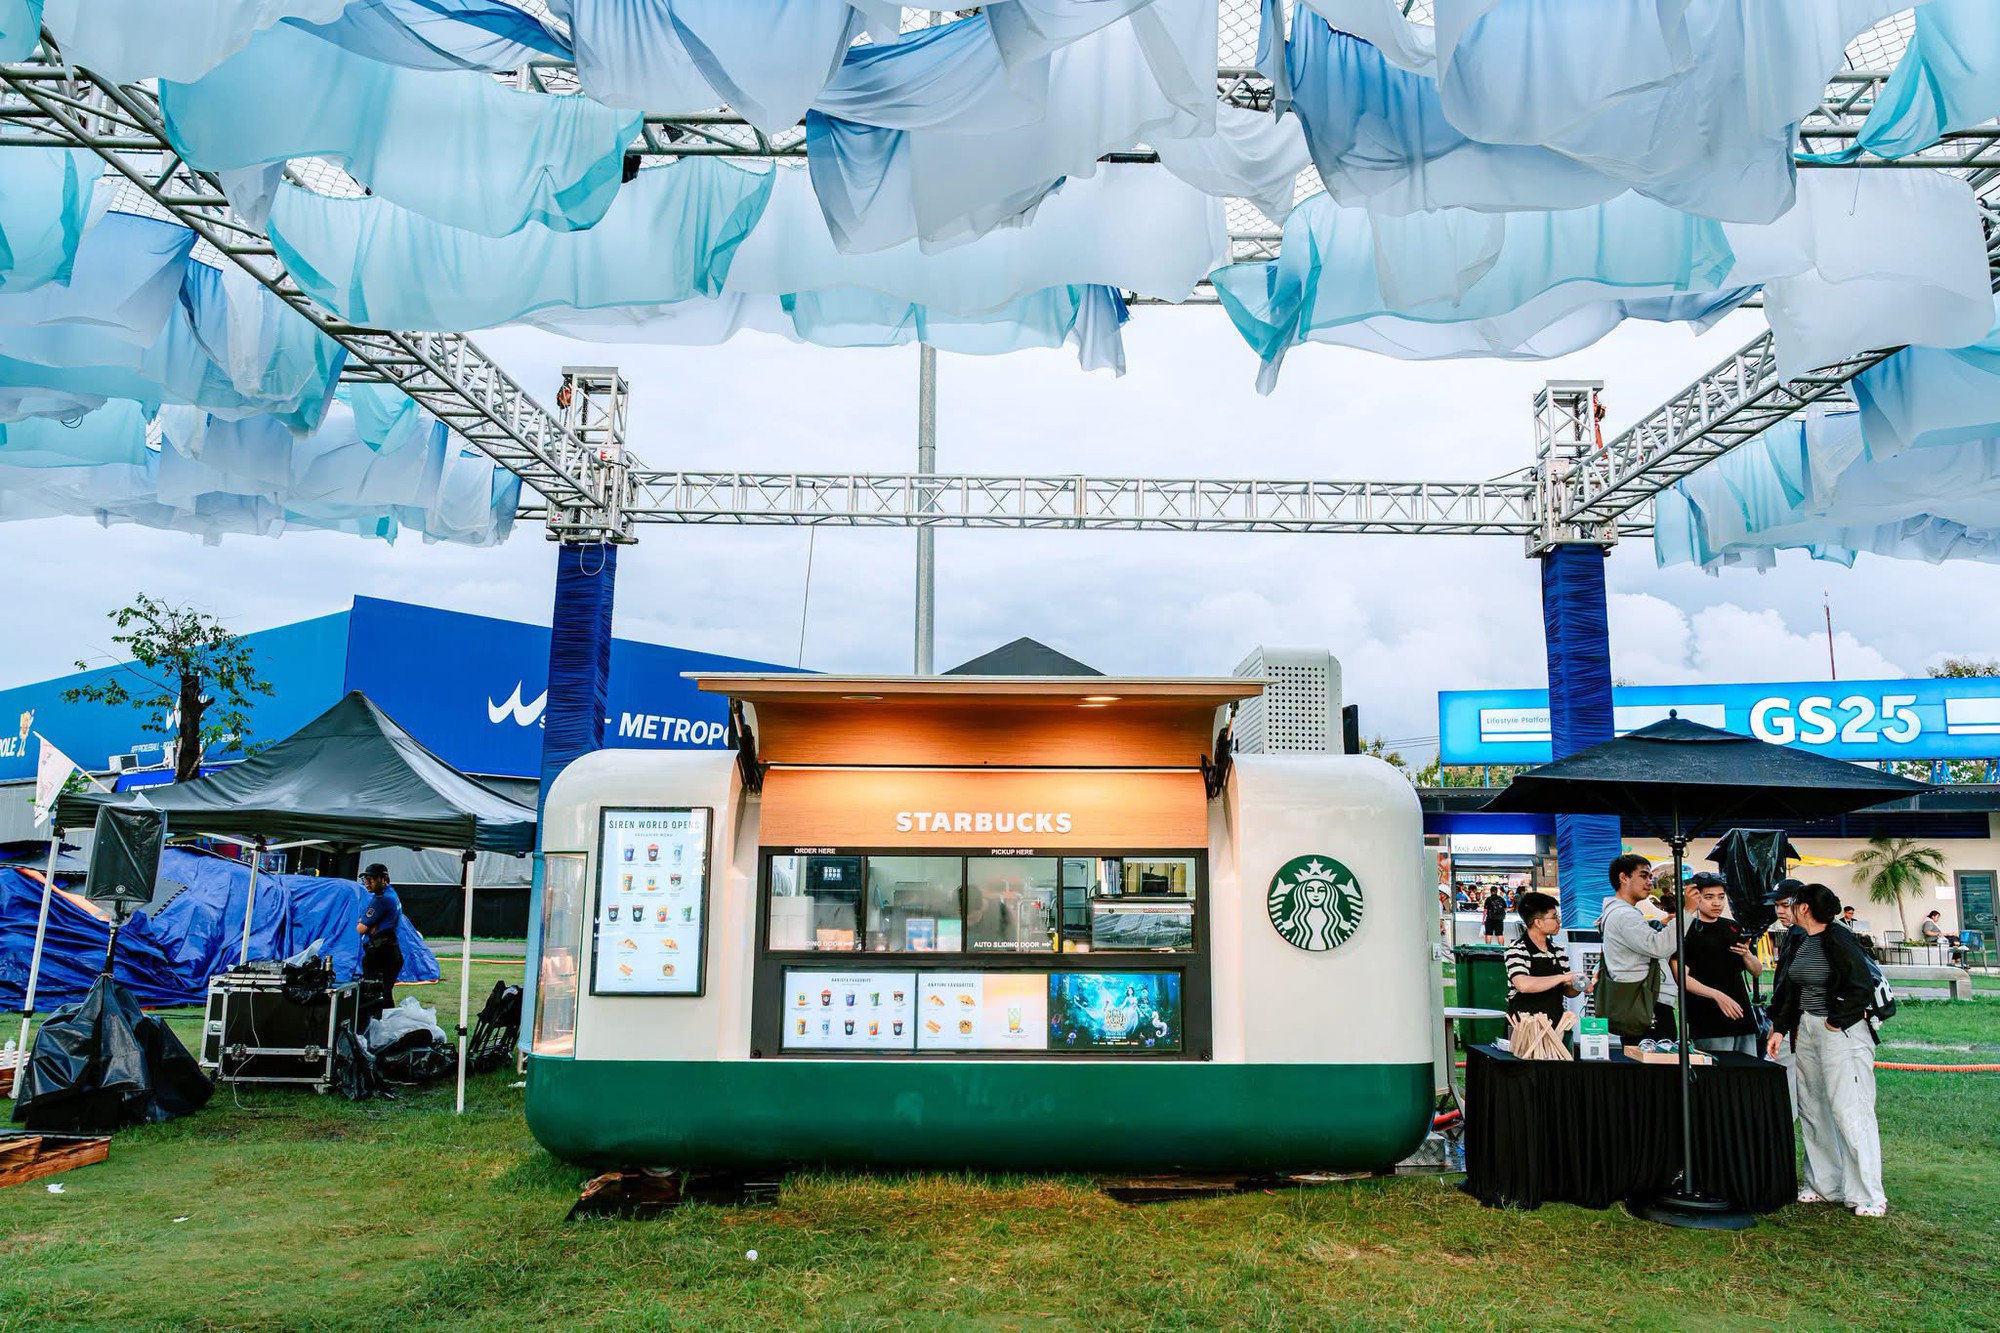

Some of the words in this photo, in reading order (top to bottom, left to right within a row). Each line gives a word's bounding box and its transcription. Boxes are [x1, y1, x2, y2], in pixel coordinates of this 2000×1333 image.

[1486, 717, 1519, 726] Lifestyle
[1749, 694, 1922, 745] GS25
[608, 820, 635, 829] SIREN
[638, 820, 669, 829] WORLD
[895, 811, 1073, 834] STARBUCKS
[794, 847, 817, 855] ORDER
[818, 847, 836, 855] HERE
